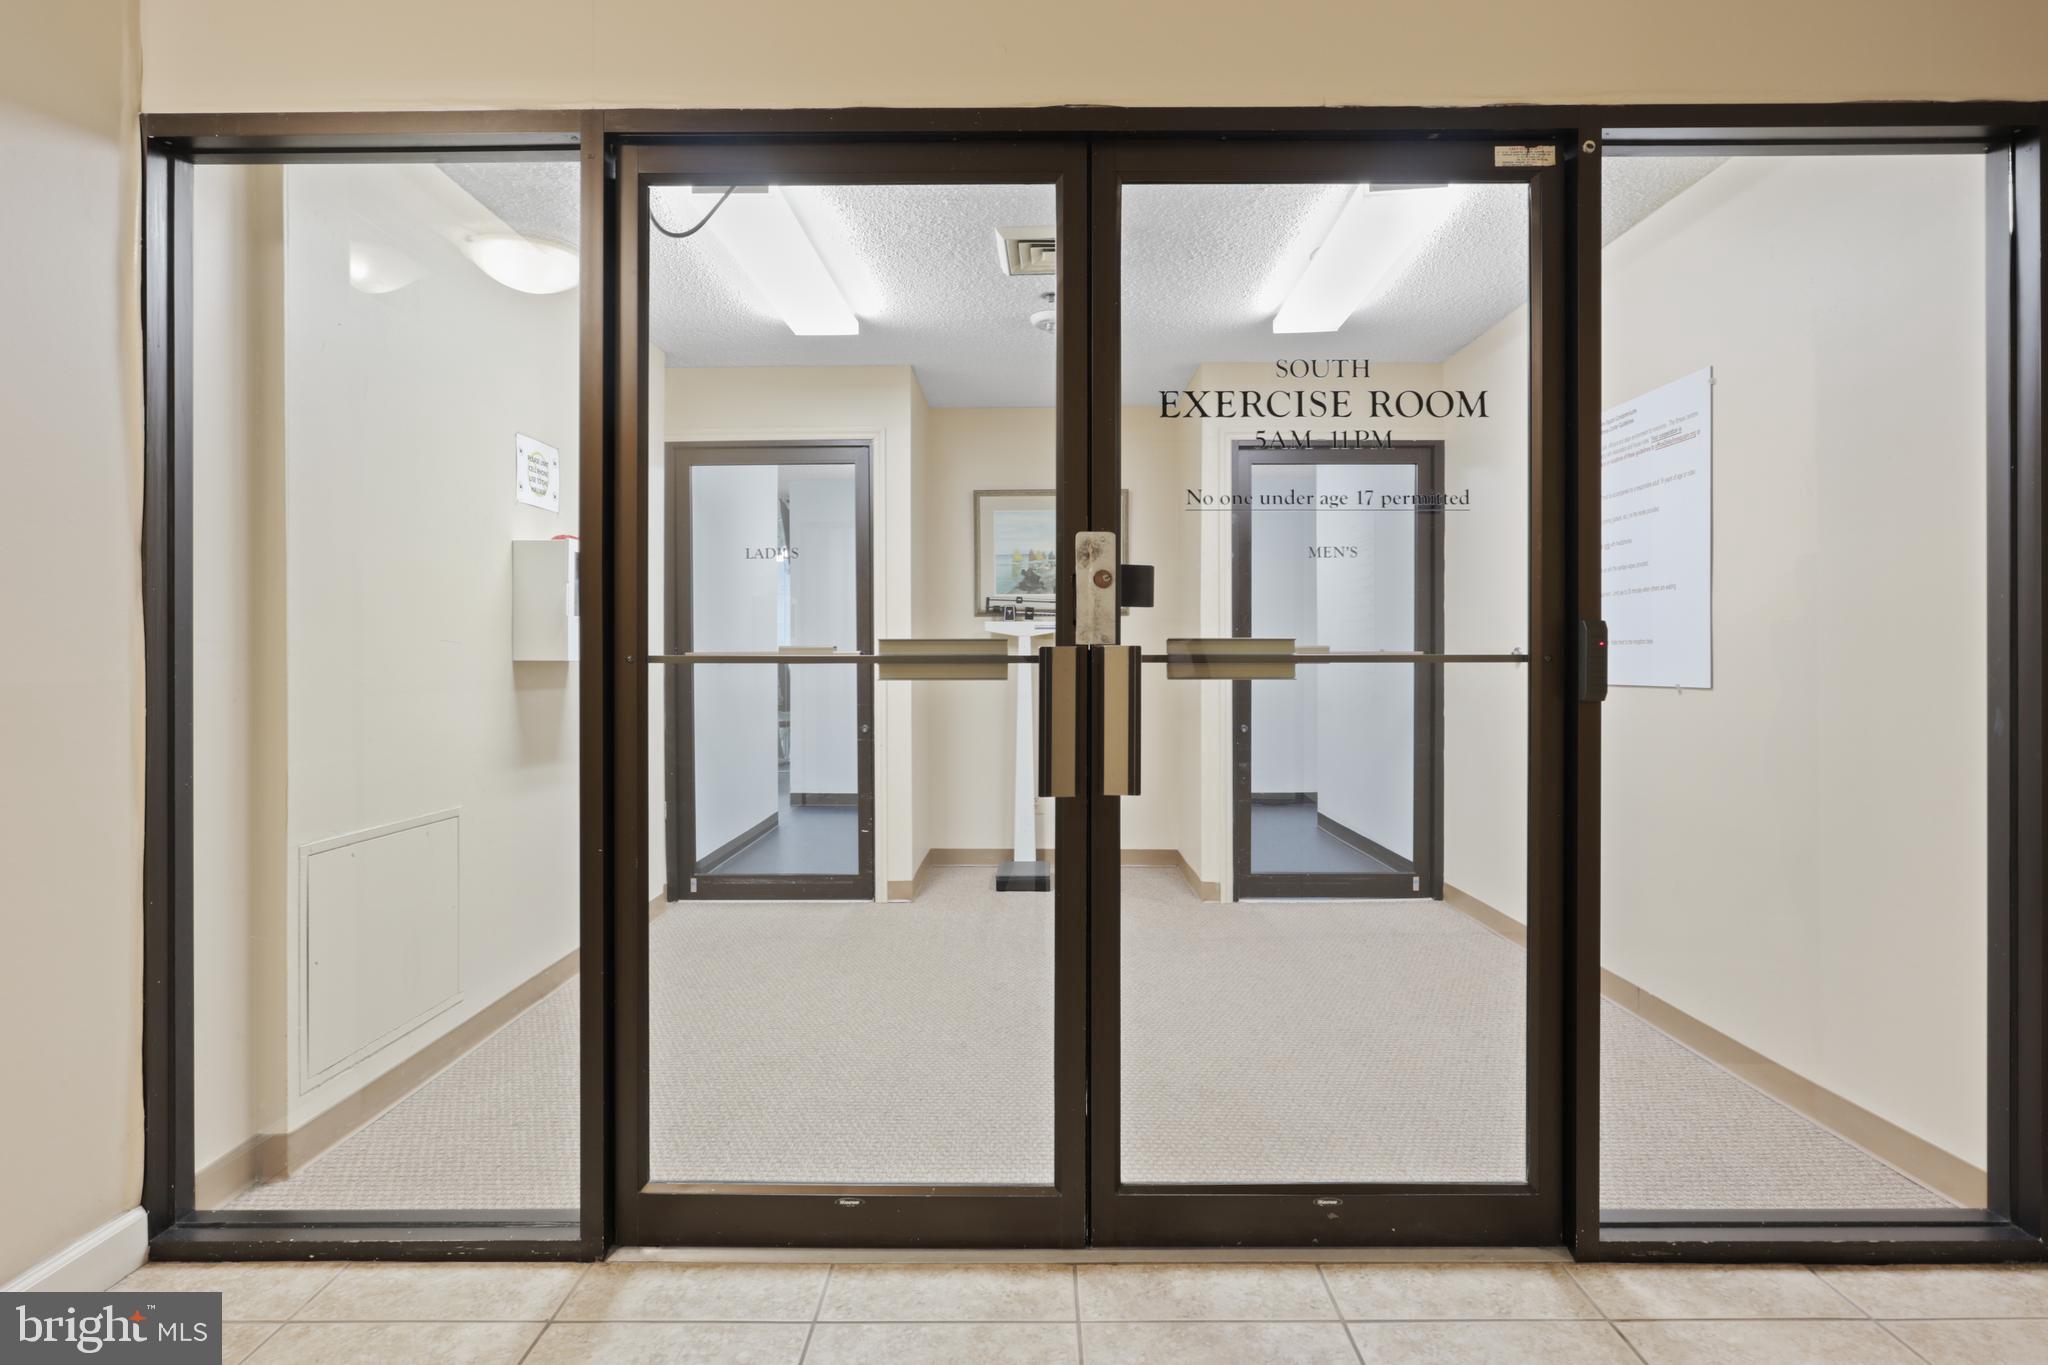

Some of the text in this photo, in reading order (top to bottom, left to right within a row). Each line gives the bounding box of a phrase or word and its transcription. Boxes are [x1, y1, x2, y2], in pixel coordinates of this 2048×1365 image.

[1275, 358, 1371, 379] SOUTH
[1158, 389, 1490, 419] EXERCISE ROOM
[1255, 429, 1395, 449] 5AM 11PM
[1186, 488, 1470, 508] No one under age 17 permitted
[1308, 545, 1358, 559] MEN'S
